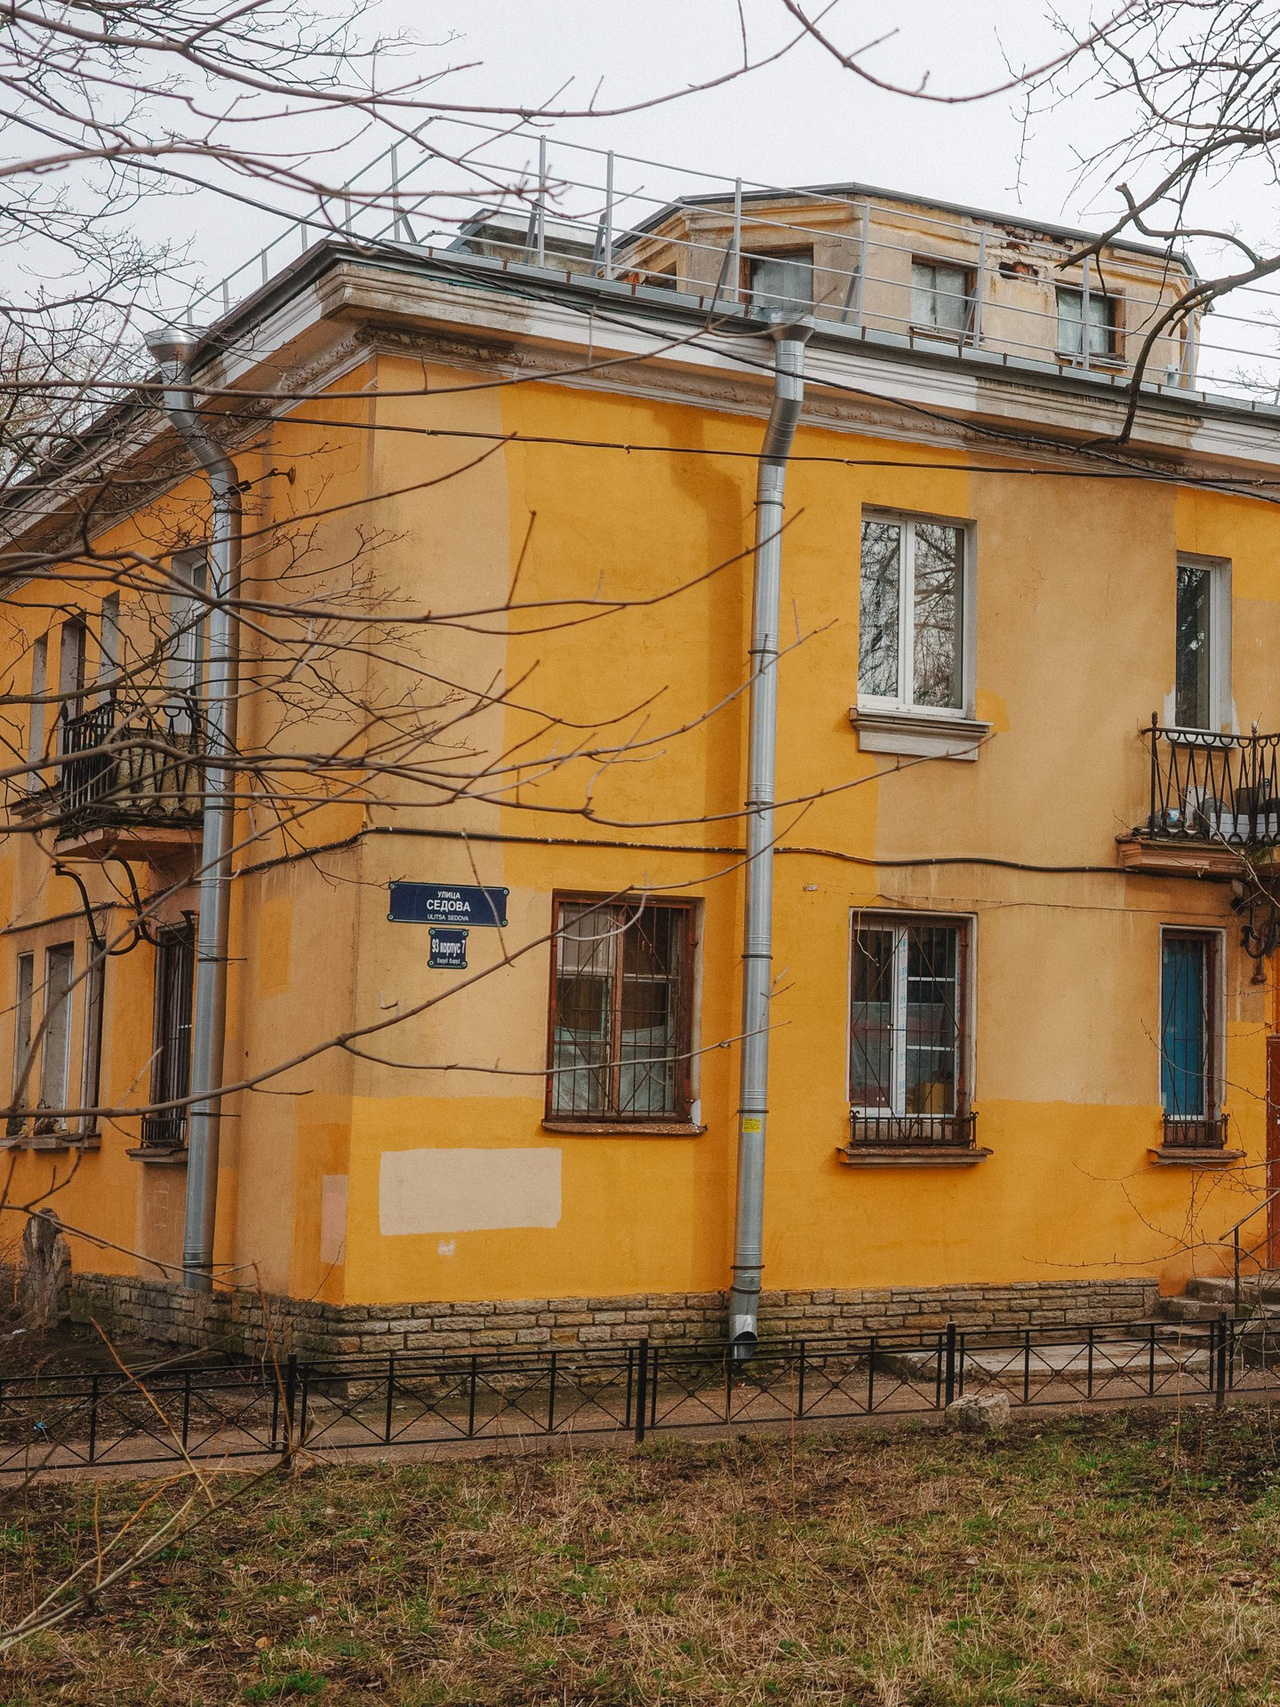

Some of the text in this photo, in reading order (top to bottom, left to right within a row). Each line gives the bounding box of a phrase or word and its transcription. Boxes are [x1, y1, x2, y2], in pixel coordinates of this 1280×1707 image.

[437, 891, 460, 899] УЛИЦА
[426, 900, 471, 912] СЕДОВА
[432, 938, 466, 957] 93 корпус 7
